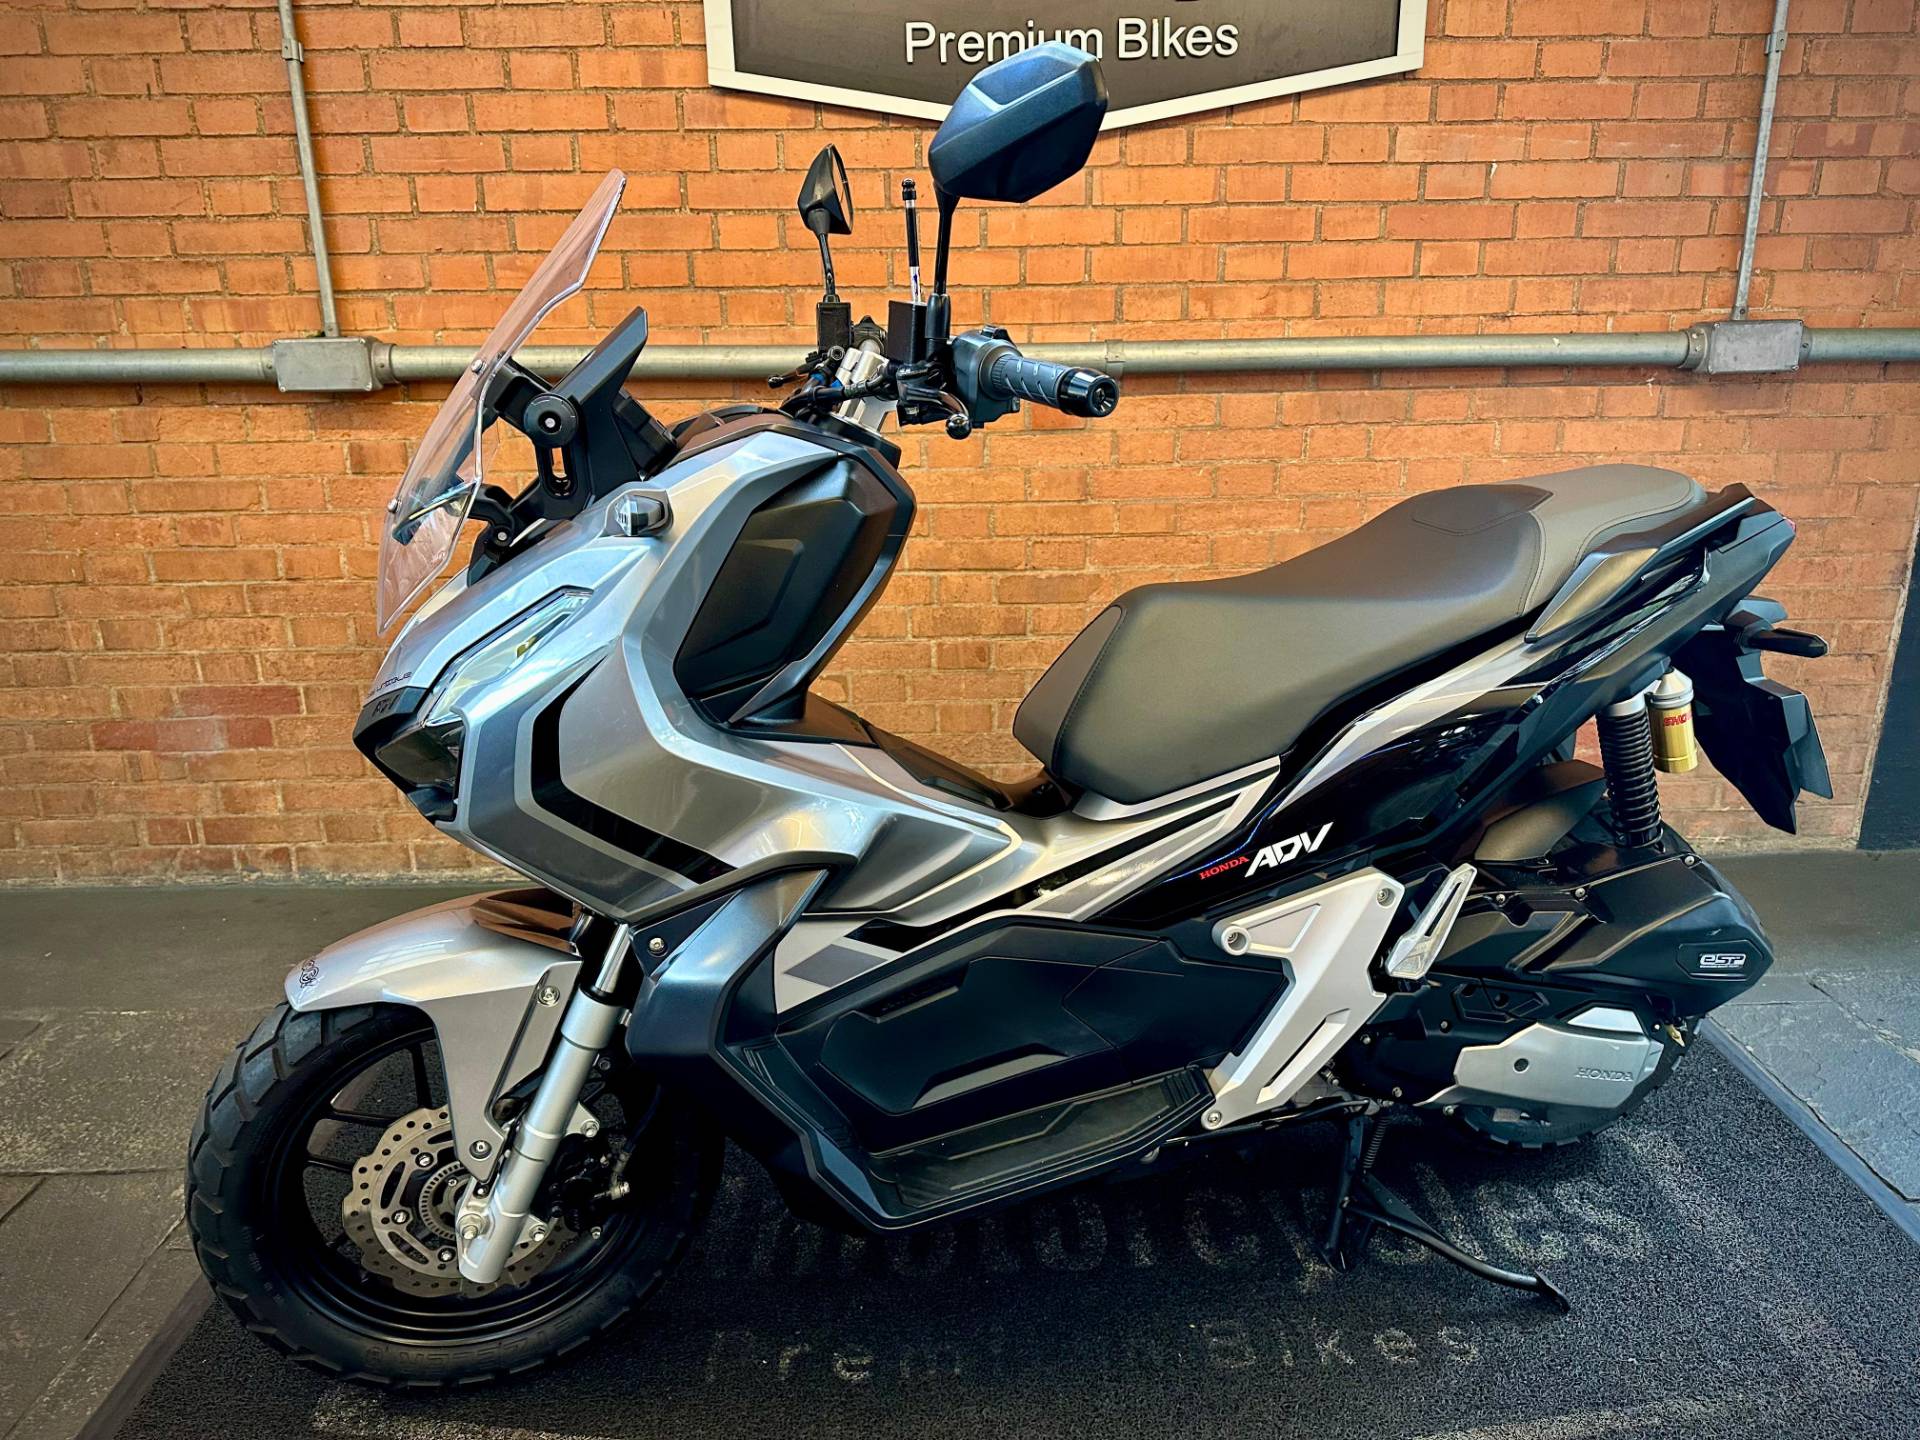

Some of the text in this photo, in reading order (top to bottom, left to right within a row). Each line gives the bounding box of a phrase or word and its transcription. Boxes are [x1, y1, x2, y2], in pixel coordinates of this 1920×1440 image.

[1200, 821, 1334, 880] HONDA ADV
[1573, 1066, 1634, 1082] HONDA
